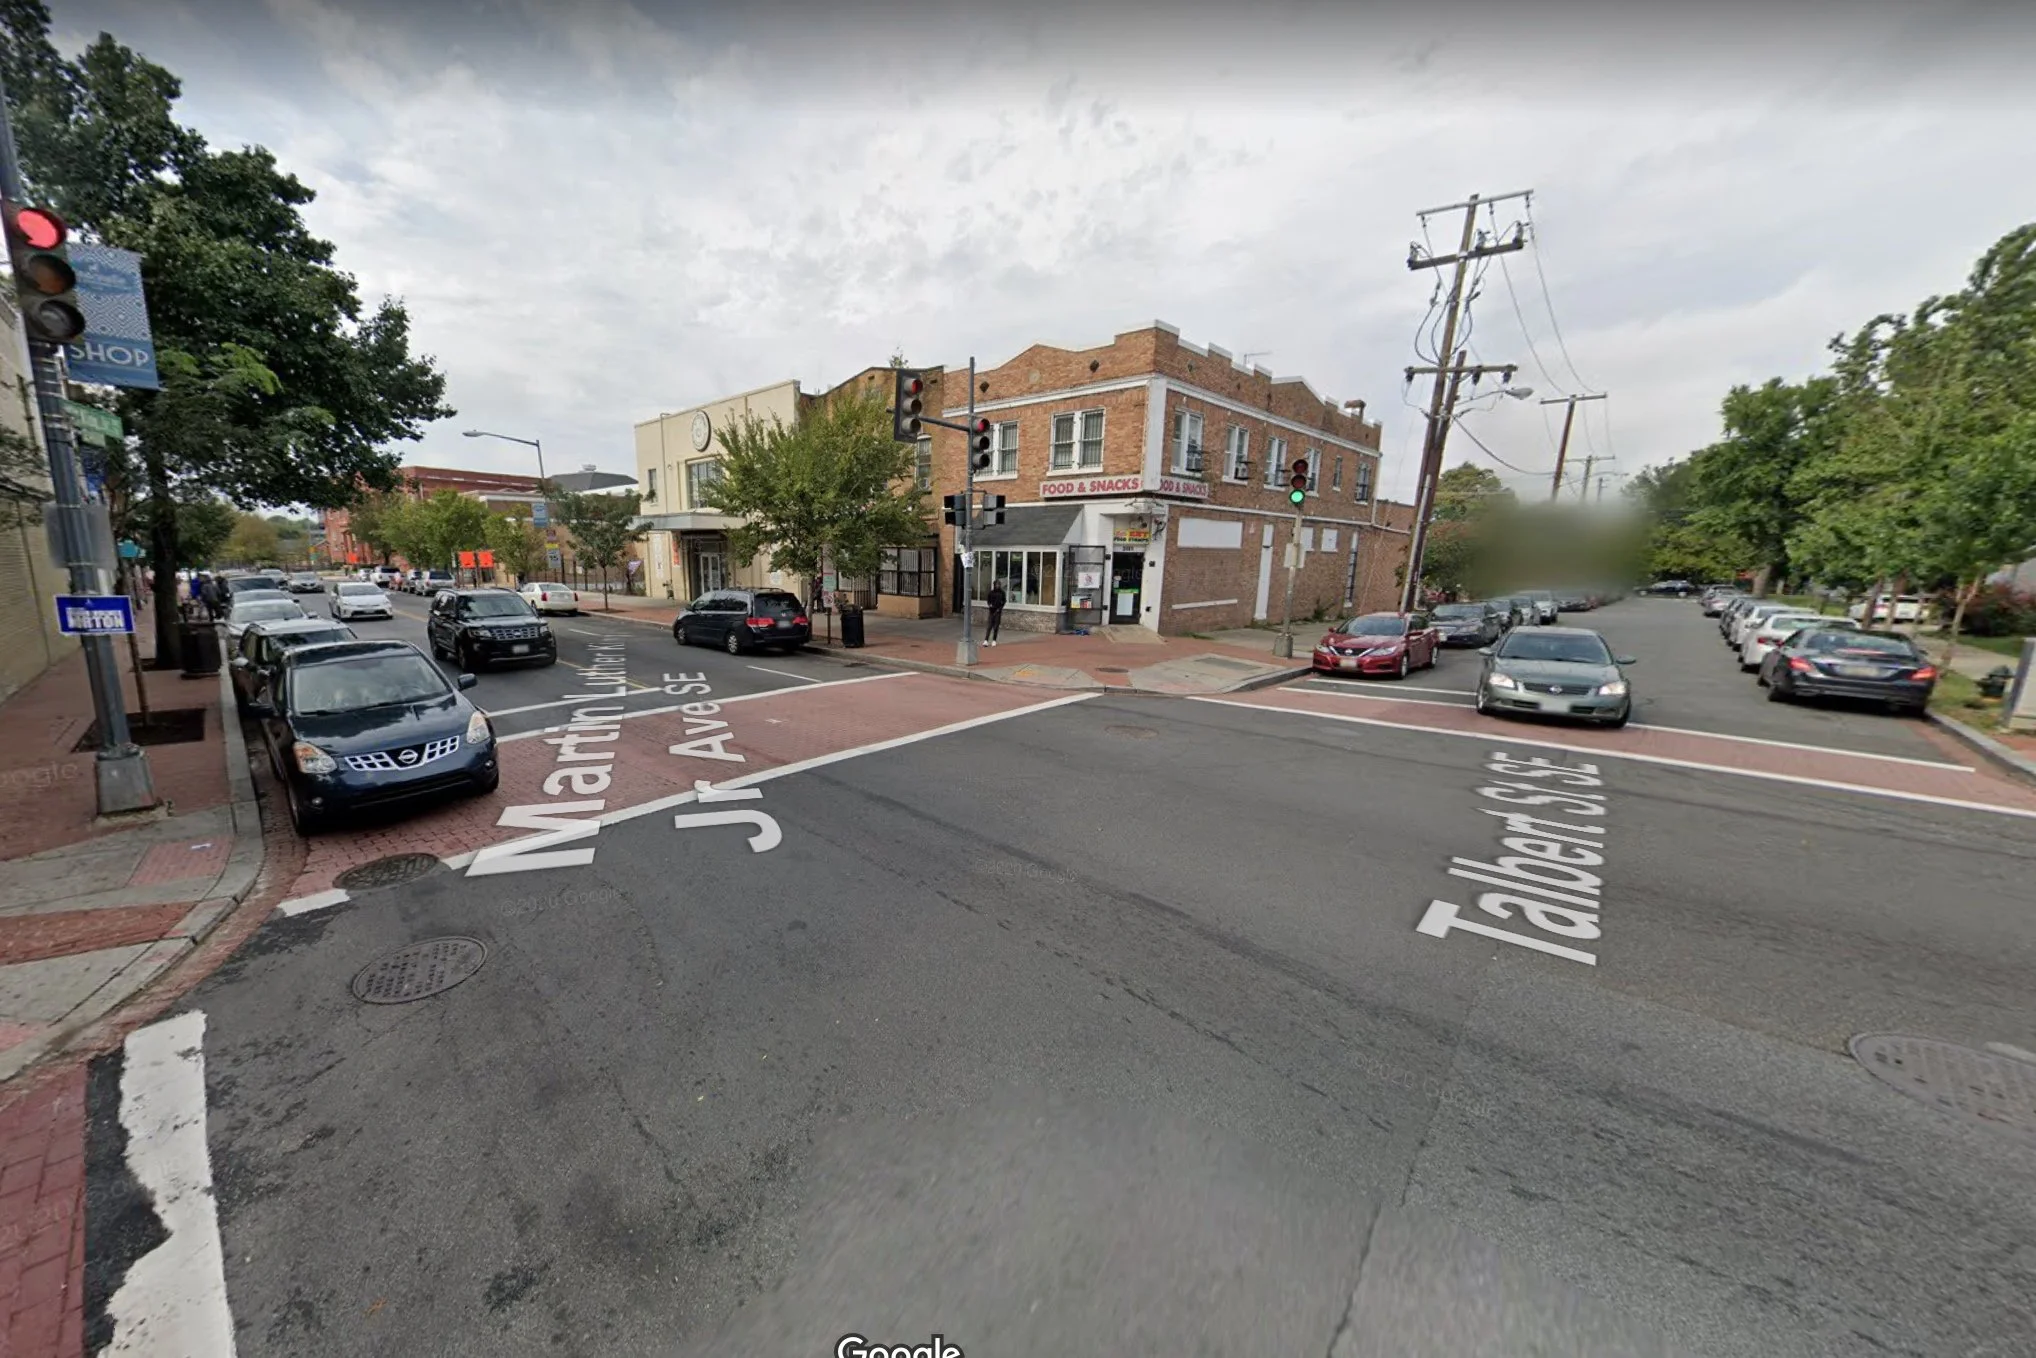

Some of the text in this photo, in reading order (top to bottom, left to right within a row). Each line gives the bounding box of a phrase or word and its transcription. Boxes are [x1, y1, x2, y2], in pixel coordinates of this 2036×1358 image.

[70, 342, 150, 367] SHOP
[1042, 477, 1139, 495] FOOD & SNACKS
[465, 706, 624, 877] Martin
[562, 651, 627, 700] Luther
[662, 671, 783, 852] Jr Ave SE
[1416, 751, 1608, 966] Talbert St SE
